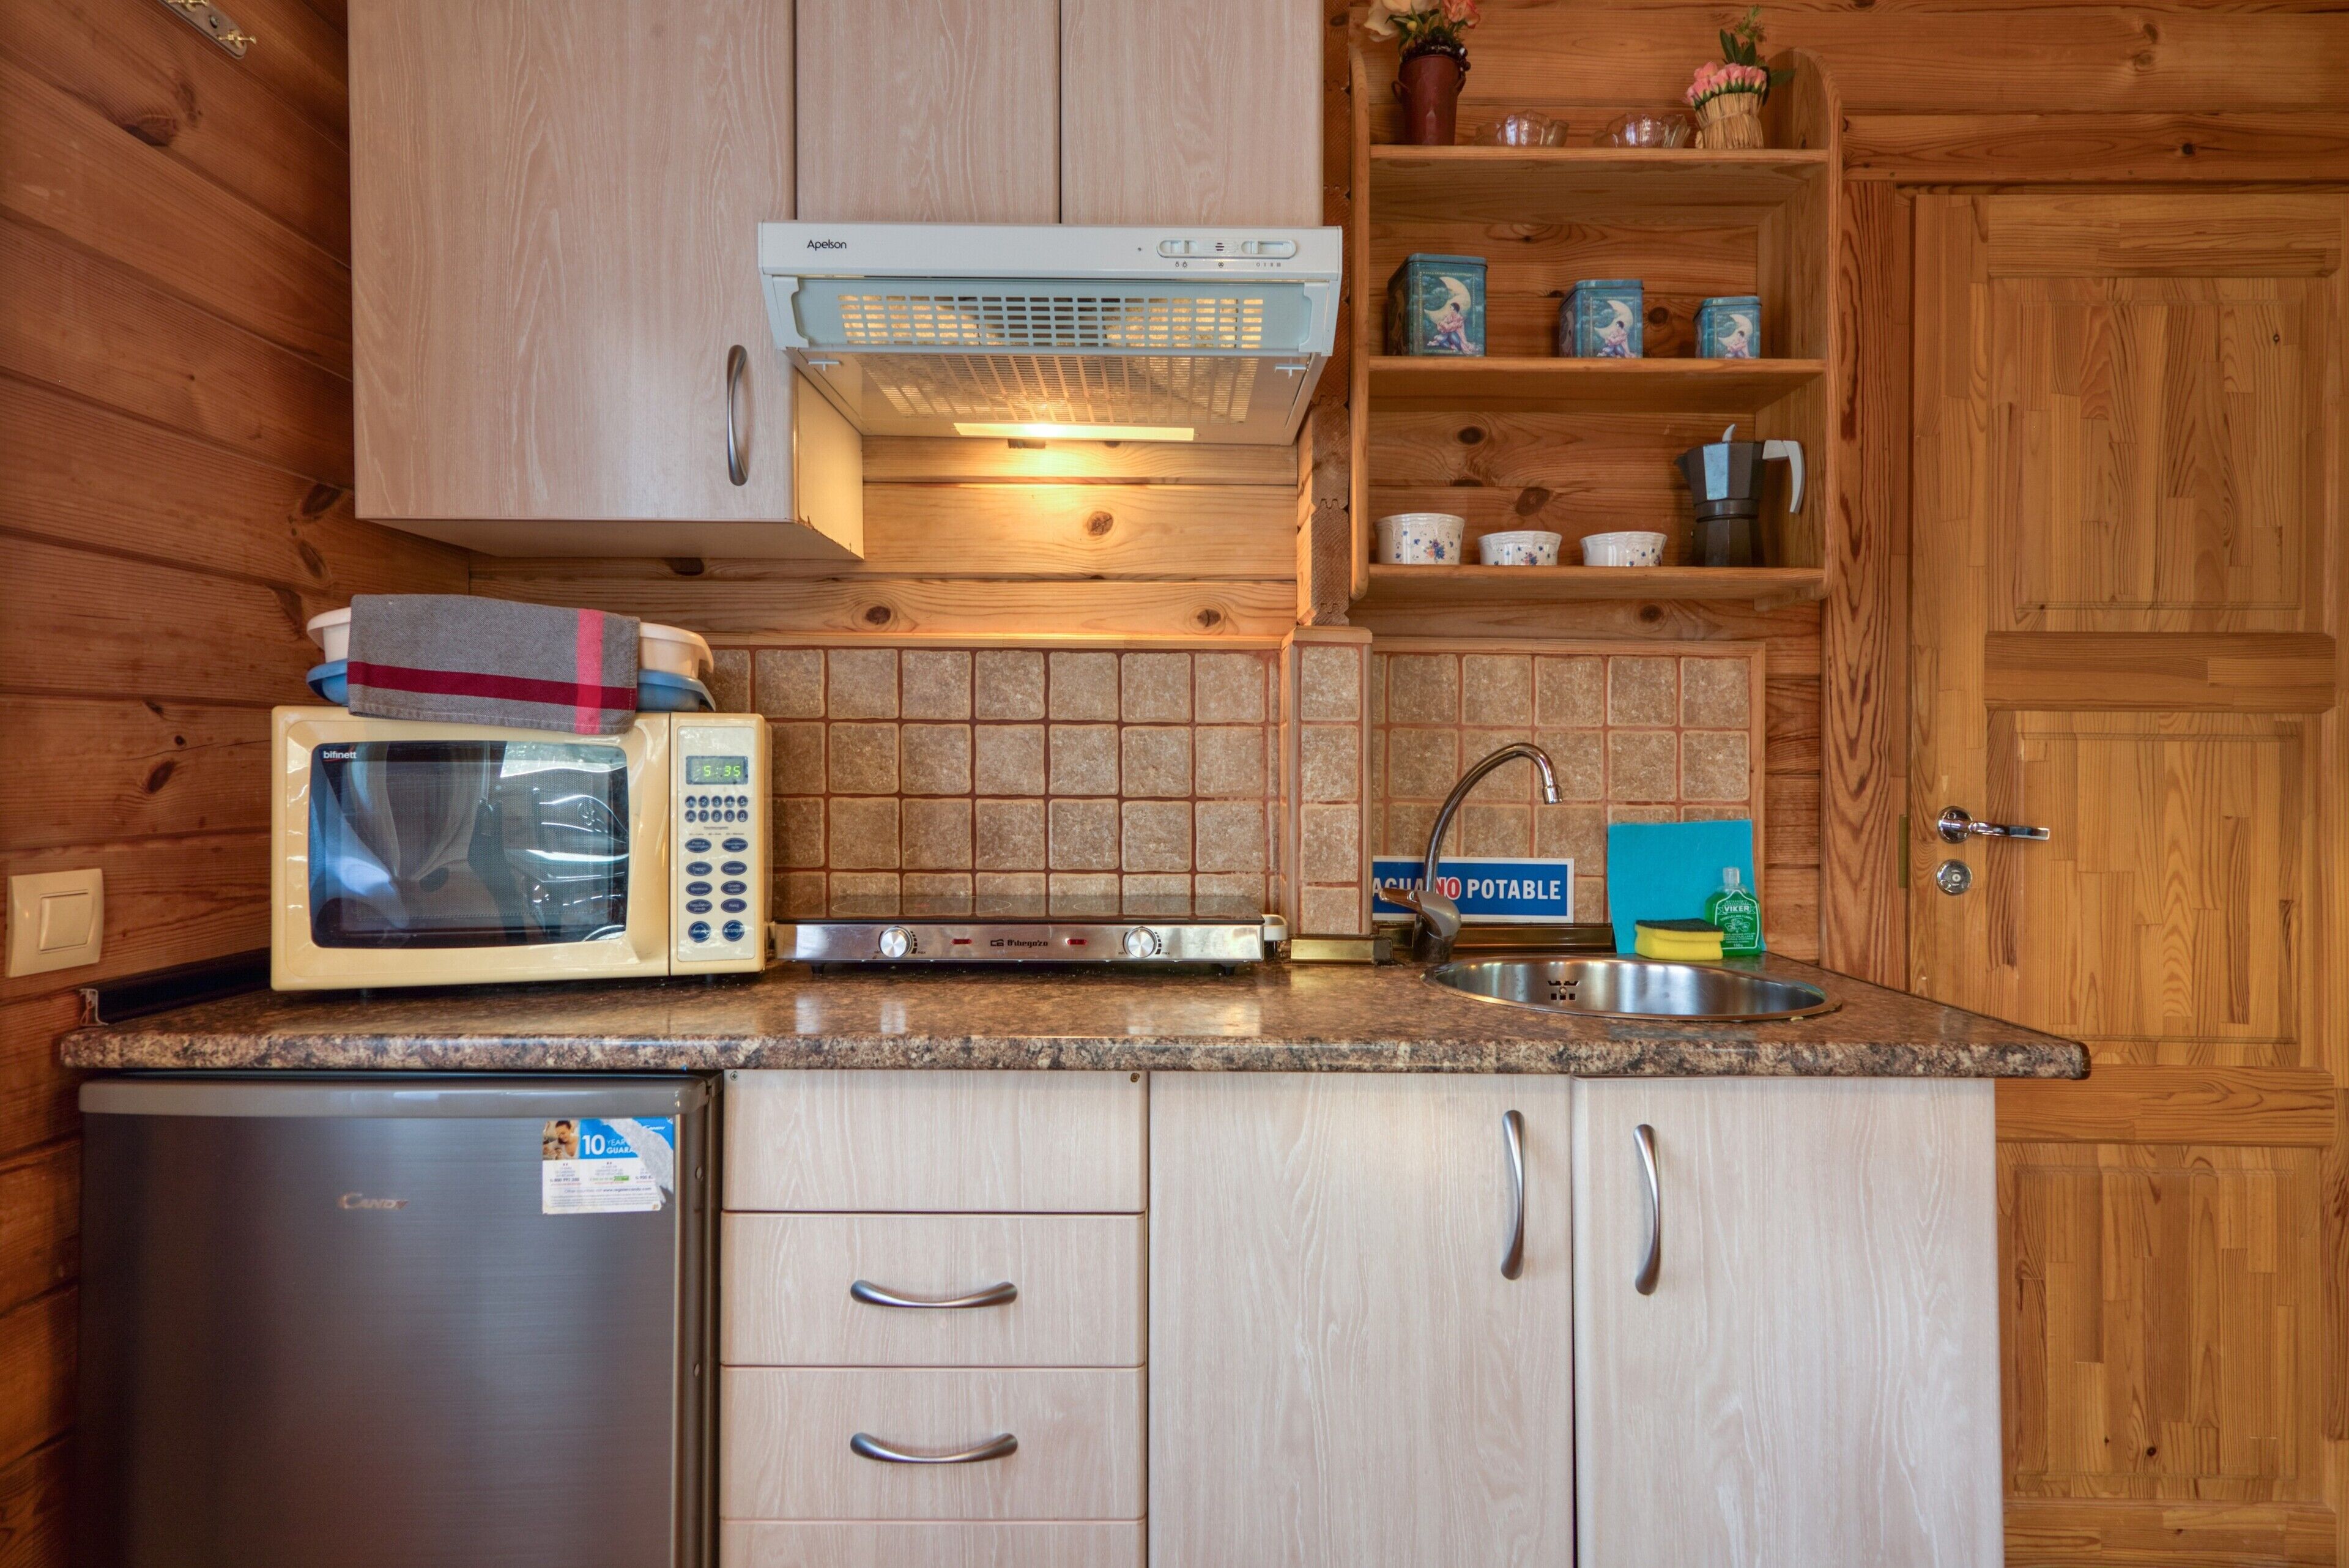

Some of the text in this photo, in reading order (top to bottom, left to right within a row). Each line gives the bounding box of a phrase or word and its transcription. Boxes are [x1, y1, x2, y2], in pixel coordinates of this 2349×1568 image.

[807, 239, 847, 251] Apelson
[1436, 877, 1462, 901] NO
[1468, 879, 1561, 900] POTABLE
[582, 1134, 606, 1155] 10
